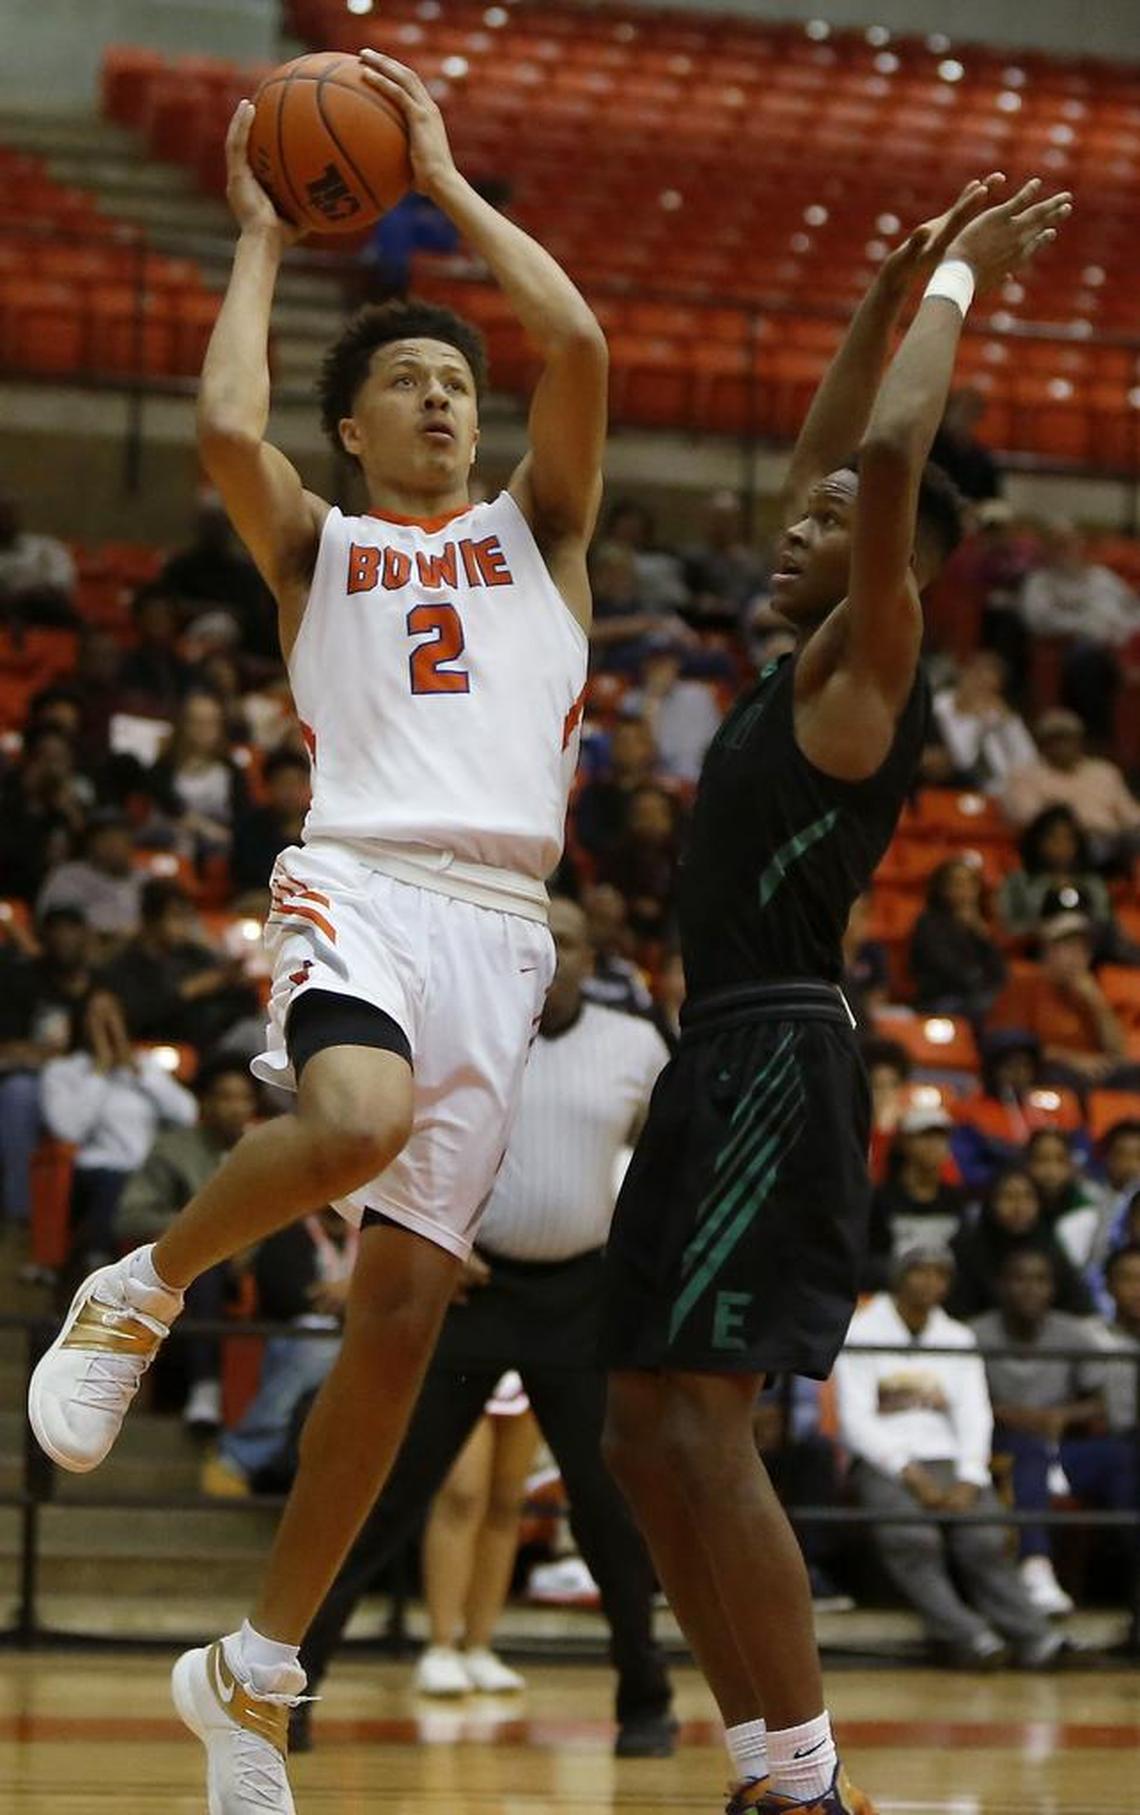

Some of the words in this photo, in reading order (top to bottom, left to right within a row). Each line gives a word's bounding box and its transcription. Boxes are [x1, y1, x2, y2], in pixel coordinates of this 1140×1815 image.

[346, 535, 513, 596] BOWIE
[406, 603, 470, 695] 2
[711, 1290, 753, 1351] E
